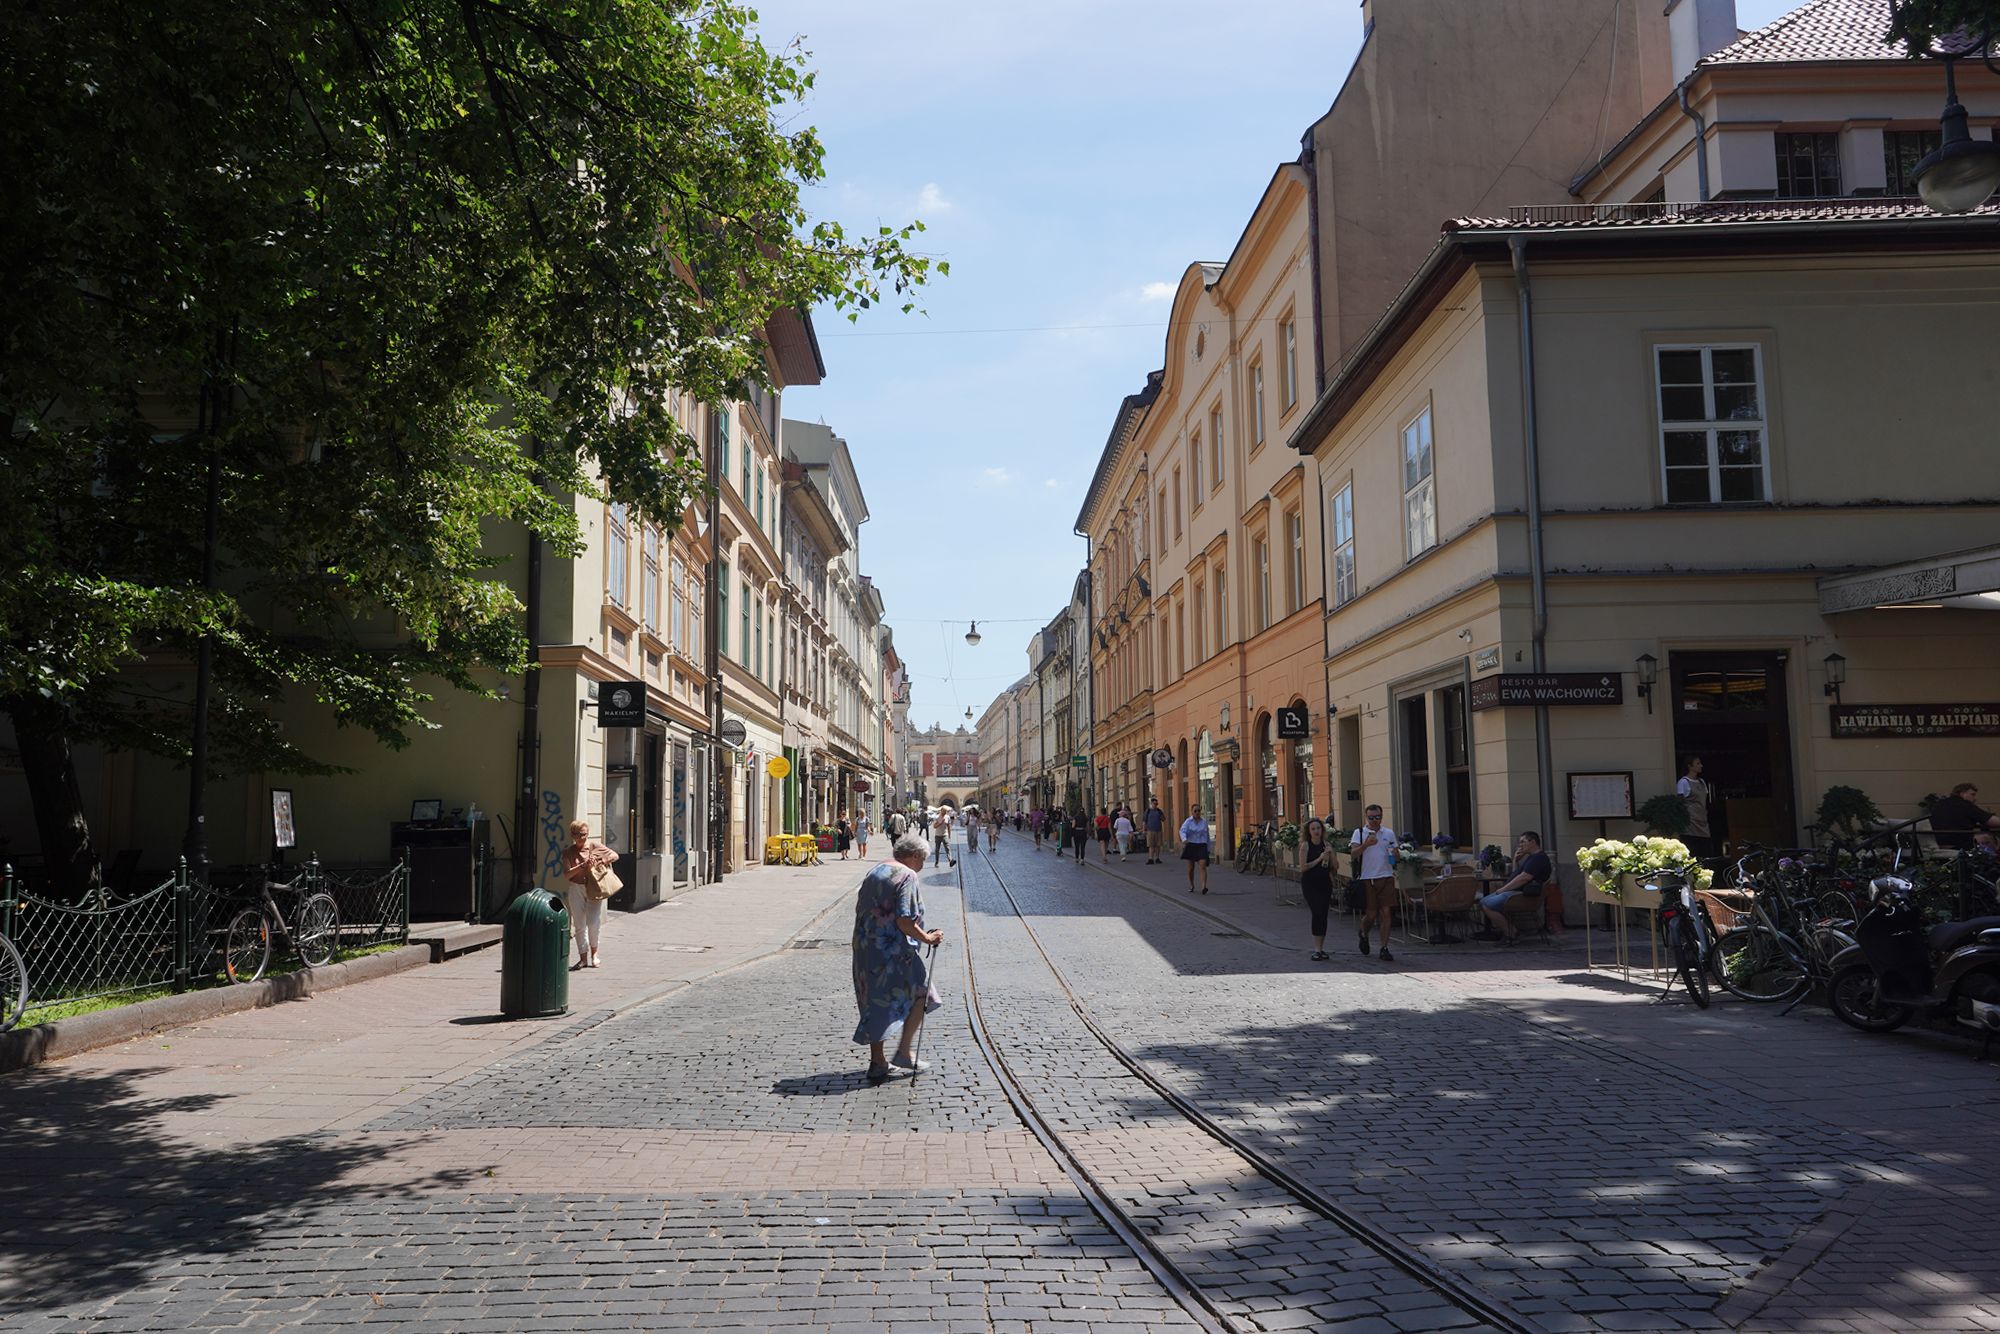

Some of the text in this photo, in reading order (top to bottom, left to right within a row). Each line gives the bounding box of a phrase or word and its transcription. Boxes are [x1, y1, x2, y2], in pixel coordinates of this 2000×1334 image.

[1501, 678, 1558, 686] RESTO BAR
[1502, 688, 1532, 700] EWA
[1534, 687, 1616, 699] WACHOWICZ
[1839, 714, 1912, 727] KAWIARNIA
[1916, 714, 1925, 726] U
